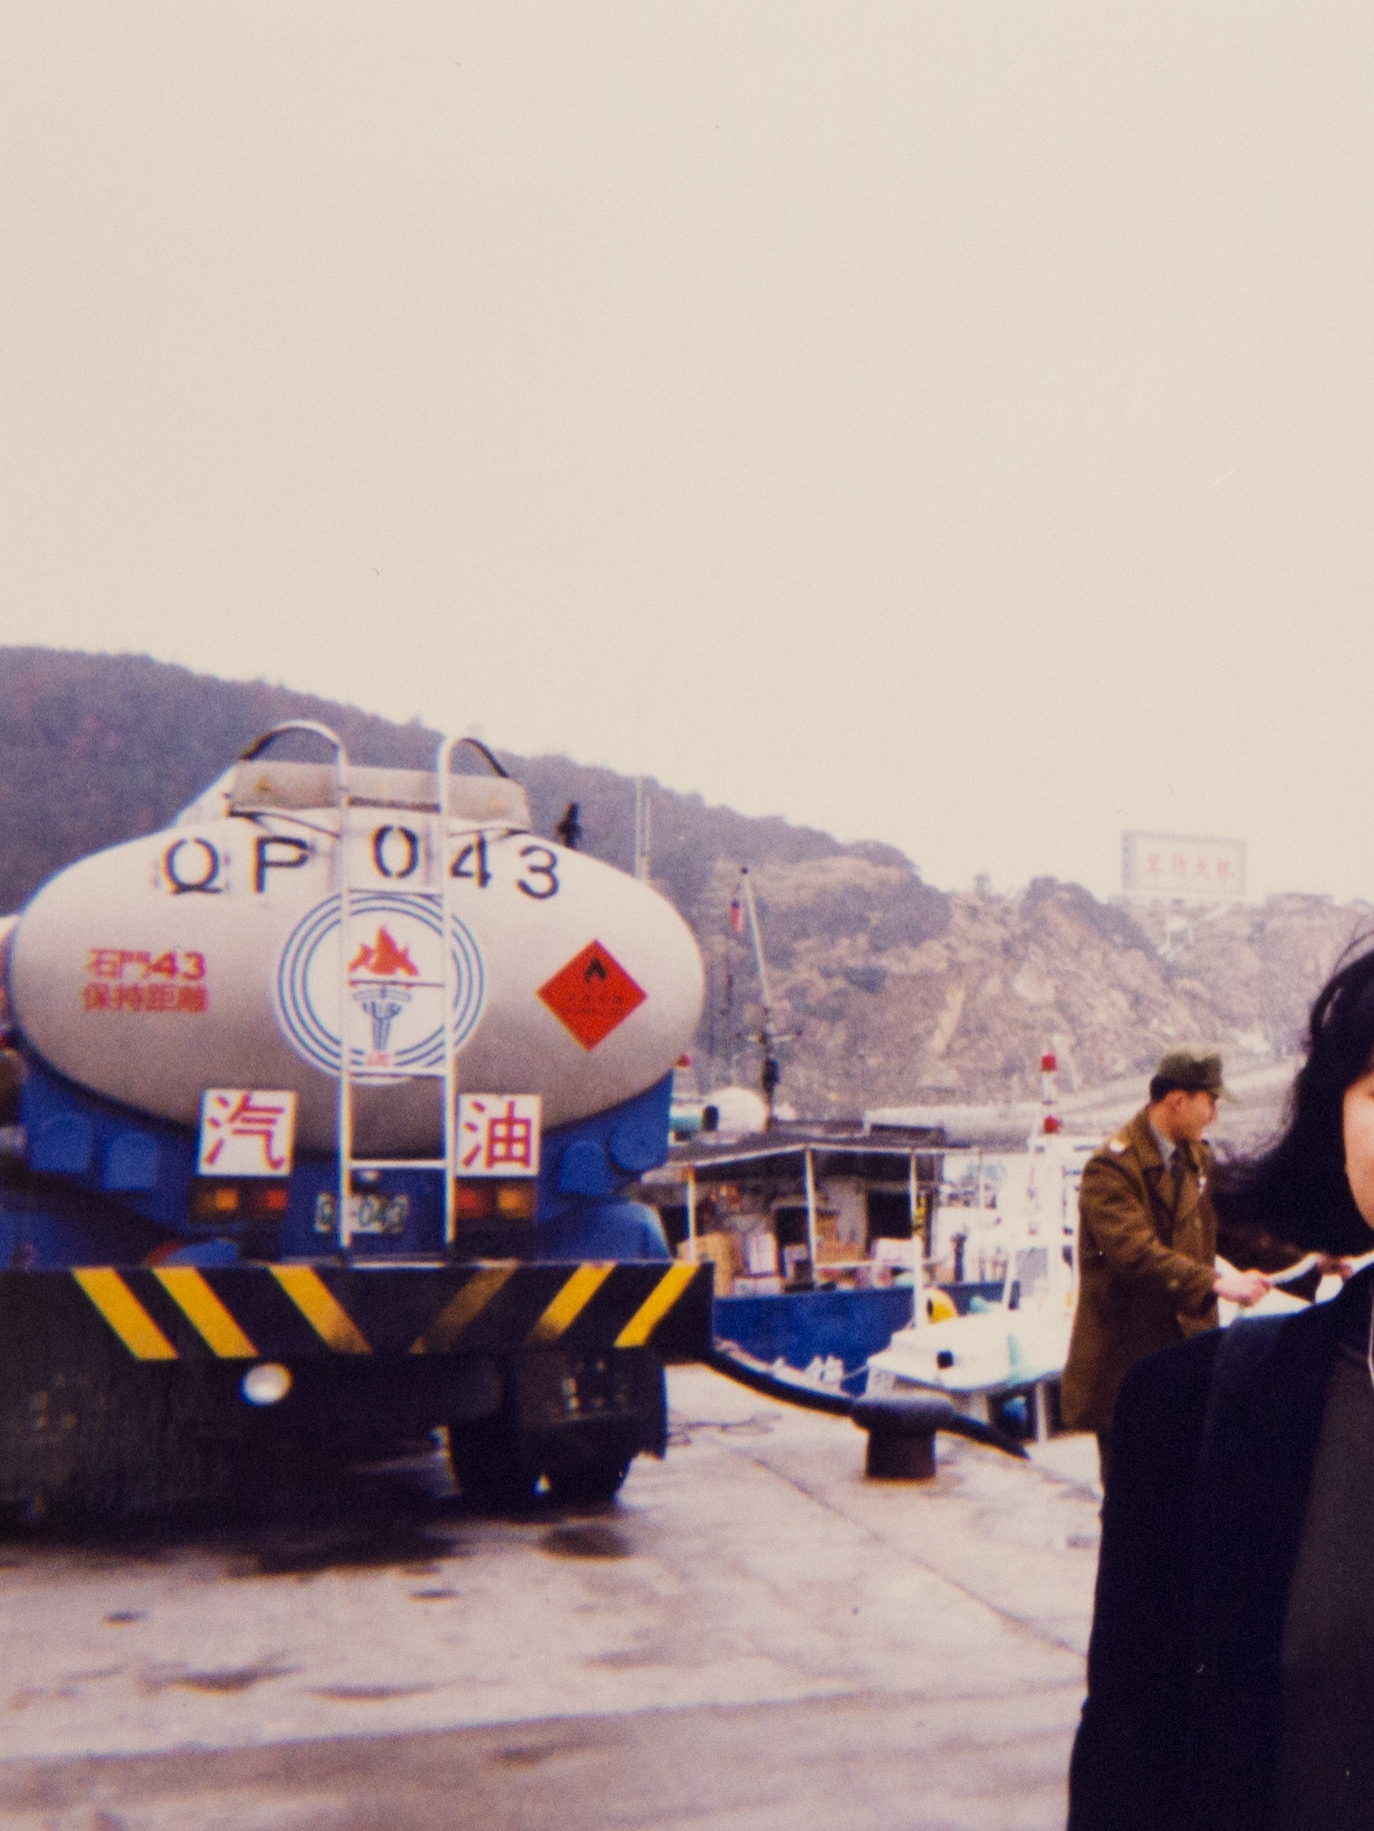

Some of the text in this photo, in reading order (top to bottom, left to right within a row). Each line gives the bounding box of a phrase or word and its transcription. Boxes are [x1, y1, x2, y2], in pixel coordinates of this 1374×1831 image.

[161, 824, 560, 899] QP 043
[203, 1094, 532, 1170] 汽 油
